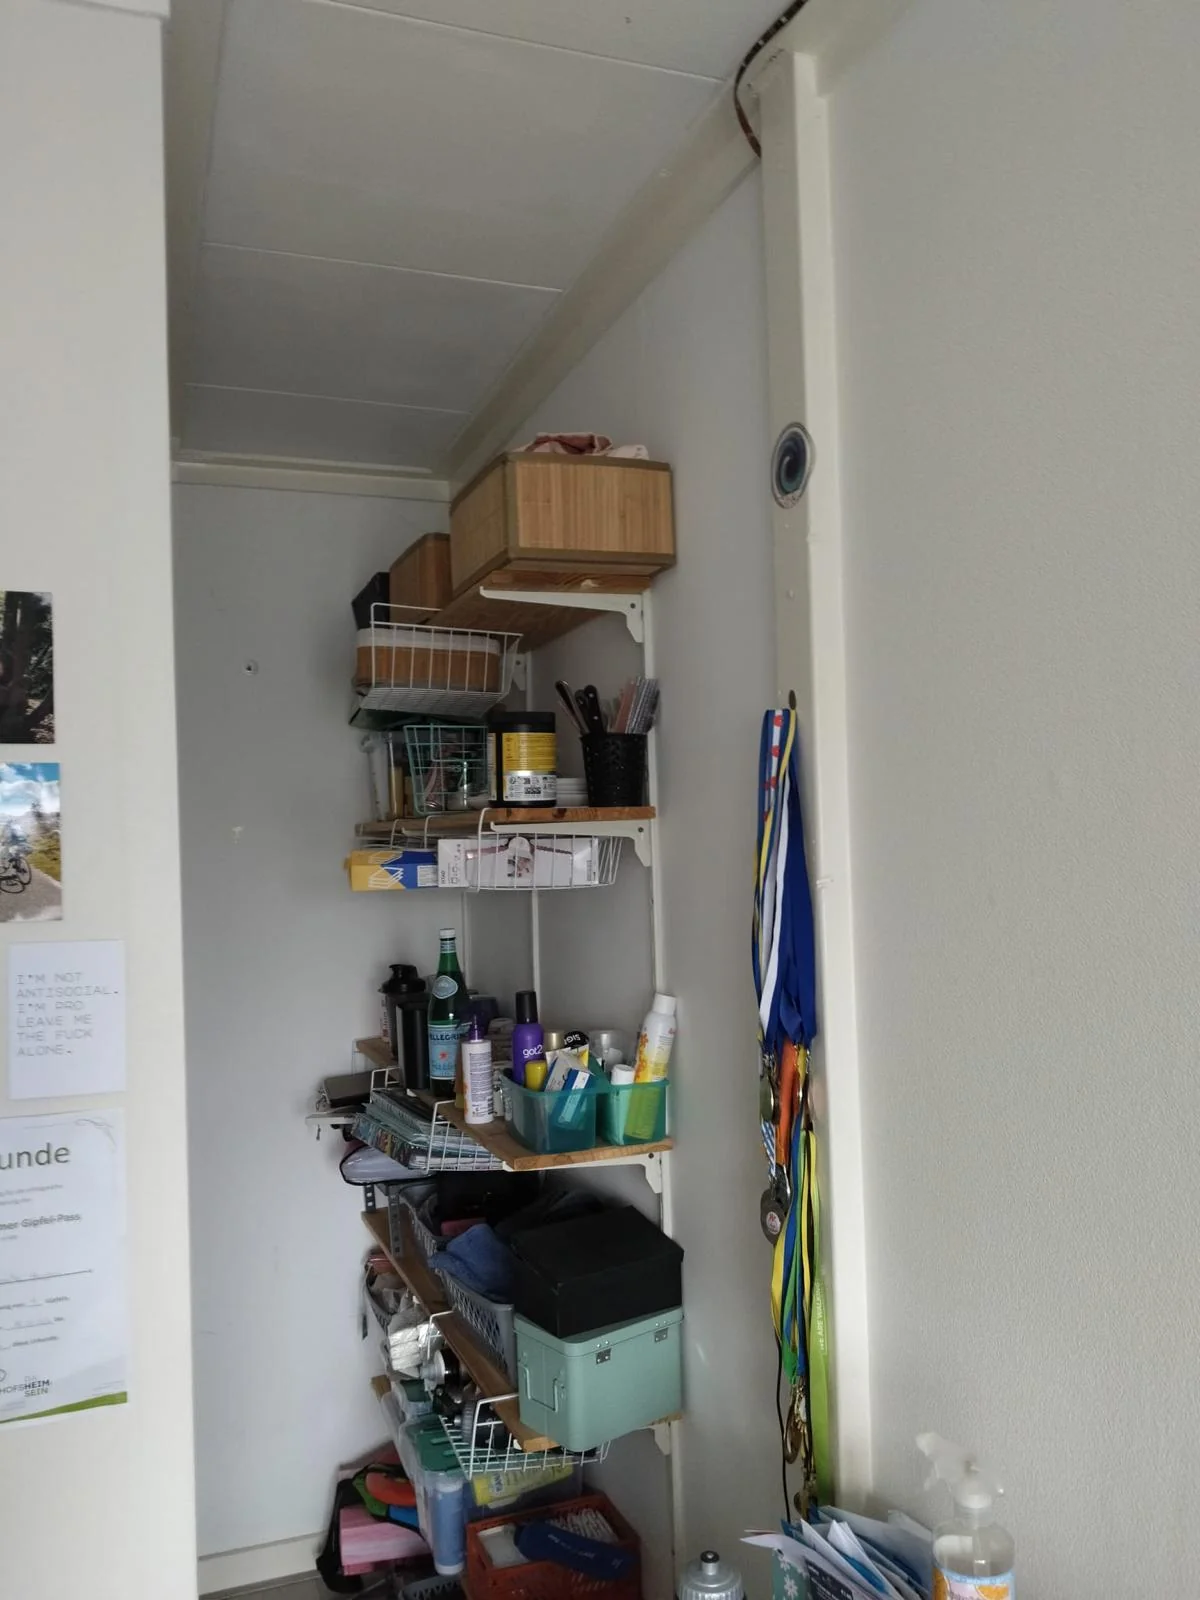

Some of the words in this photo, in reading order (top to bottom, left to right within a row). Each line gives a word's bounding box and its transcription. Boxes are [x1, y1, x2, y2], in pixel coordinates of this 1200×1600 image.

[54, 972, 82, 983] NOT
[16, 985, 119, 999] ANTISOCIAL.
[55, 1000, 85, 1011] PRO
[16, 1015, 64, 1028] LEAVE
[74, 1013, 94, 1025] ME
[16, 1030, 45, 1042] THE
[54, 1028, 94, 1040] FUCK
[16, 1044, 72, 1057] ALONE.
[24, 1387, 49, 1398] SEIN
